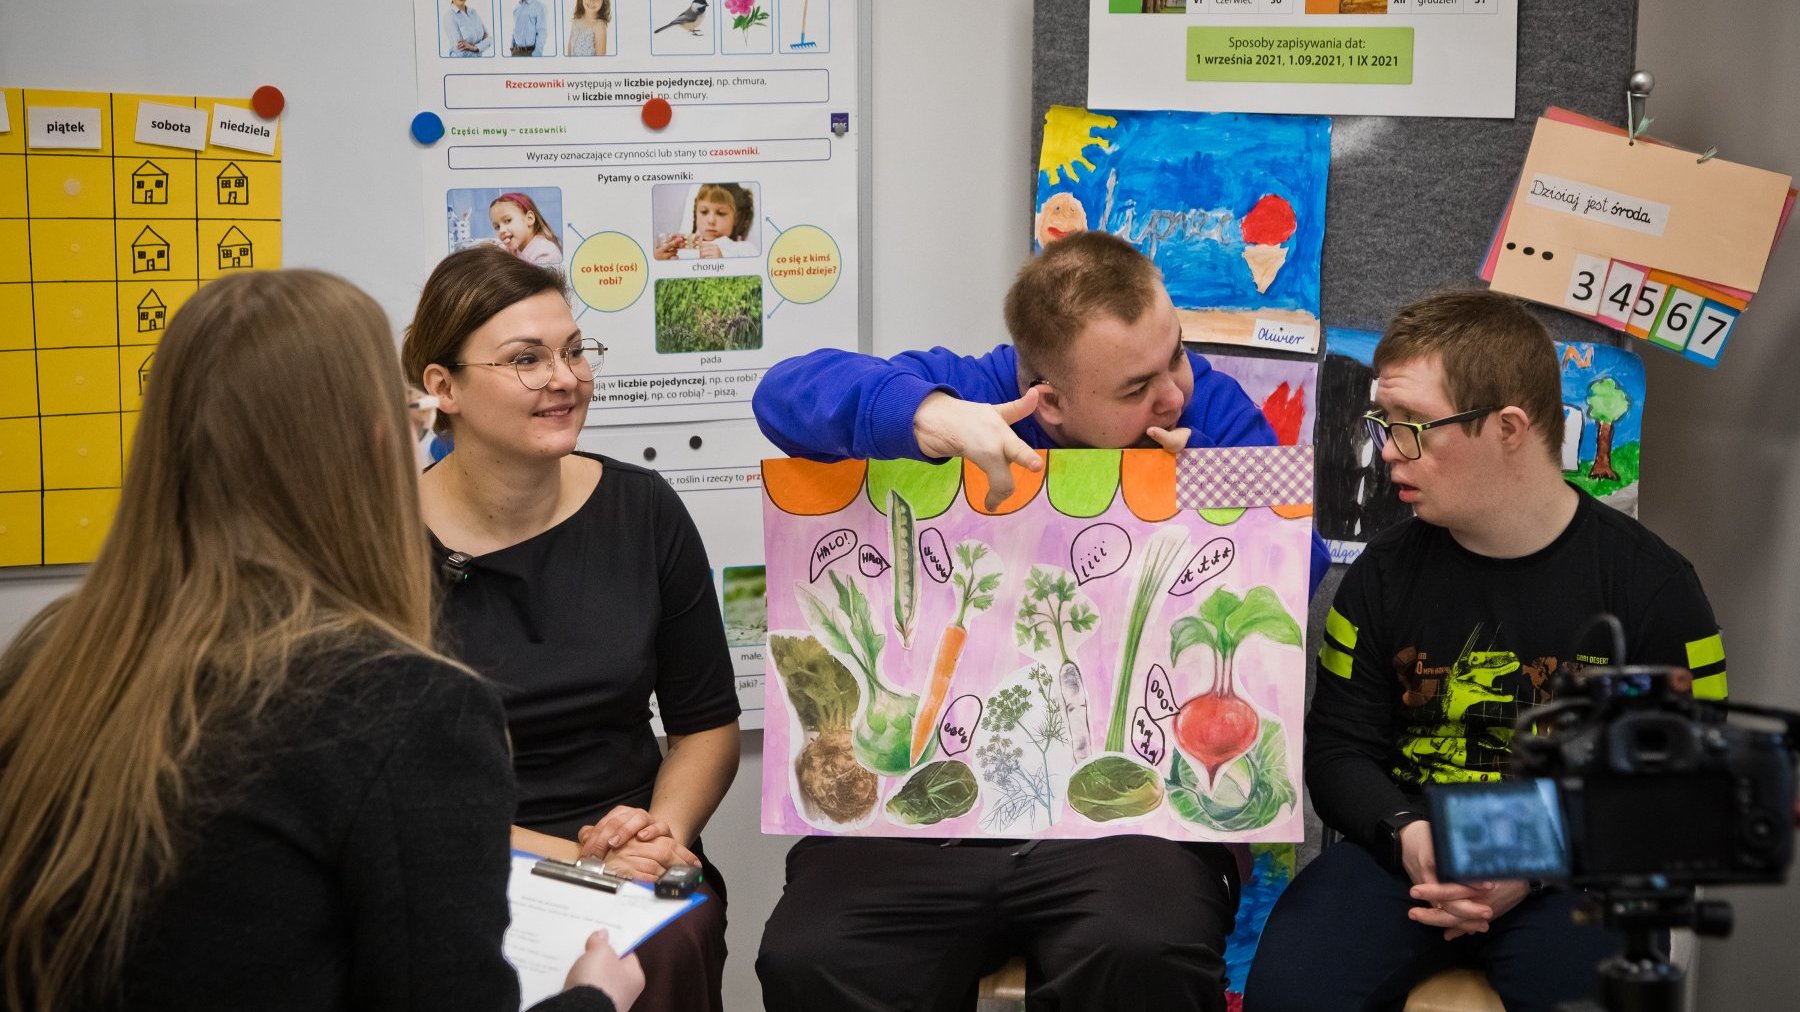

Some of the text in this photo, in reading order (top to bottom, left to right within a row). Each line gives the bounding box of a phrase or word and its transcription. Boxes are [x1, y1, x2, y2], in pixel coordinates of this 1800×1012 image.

[1228, 36, 1366, 50] Sposoby zapisywania dat:
[1196, 54, 1399, 67] 1 września 2021, 1.09.2021, 1 IX 2021
[505, 79, 565, 89] Rzeczowniki
[567, 79, 612, 90] występują
[624, 78, 654, 87] liczbie
[656, 77, 714, 88] pojedynczej,
[716, 78, 729, 87] np.
[732, 76, 767, 86] chmura,
[582, 92, 613, 101] liczbie
[673, 91, 708, 101] chmury.
[46, 120, 85, 134] piątek
[151, 119, 191, 134] sobota
[219, 118, 271, 138] niedziela
[451, 126, 480, 137] Części
[483, 128, 508, 137] mowy
[519, 125, 567, 134] czasowniki
[526, 146, 760, 162] Wyrazy oznaczające czynności lub stany to czasowniki.
[598, 173, 632, 184] Pytamy
[642, 171, 694, 182] czasowniki:
[1531, 180, 1581, 211] Dzisiaj
[1584, 196, 1608, 214] jest
[776, 256, 787, 264] co
[789, 254, 801, 264] się
[810, 252, 831, 263] kimś
[593, 263, 614, 272] ktoś
[616, 262, 638, 272] (coś)
[692, 261, 725, 272] choruje
[770, 265, 837, 278] (czymś) dzieje?
[599, 276, 623, 285] robi?
[1572, 271, 1728, 345] 3 4 5 6 7
[700, 355, 722, 366] pada
[617, 378, 648, 389] liczbie
[649, 375, 708, 389] pojedynczej,
[709, 377, 722, 386] np.
[737, 373, 758, 382] robi?
[608, 390, 649, 402] mnogiej,
[651, 393, 664, 401] np.
[666, 391, 677, 399] co
[679, 388, 705, 398] robią?
[714, 388, 738, 398] piszą.
[676, 474, 700, 484] roślin
[707, 475, 733, 484] rzeczy
[735, 473, 744, 481] to
[817, 532, 850, 562] HALO!
[739, 679, 758, 690] jaki?
